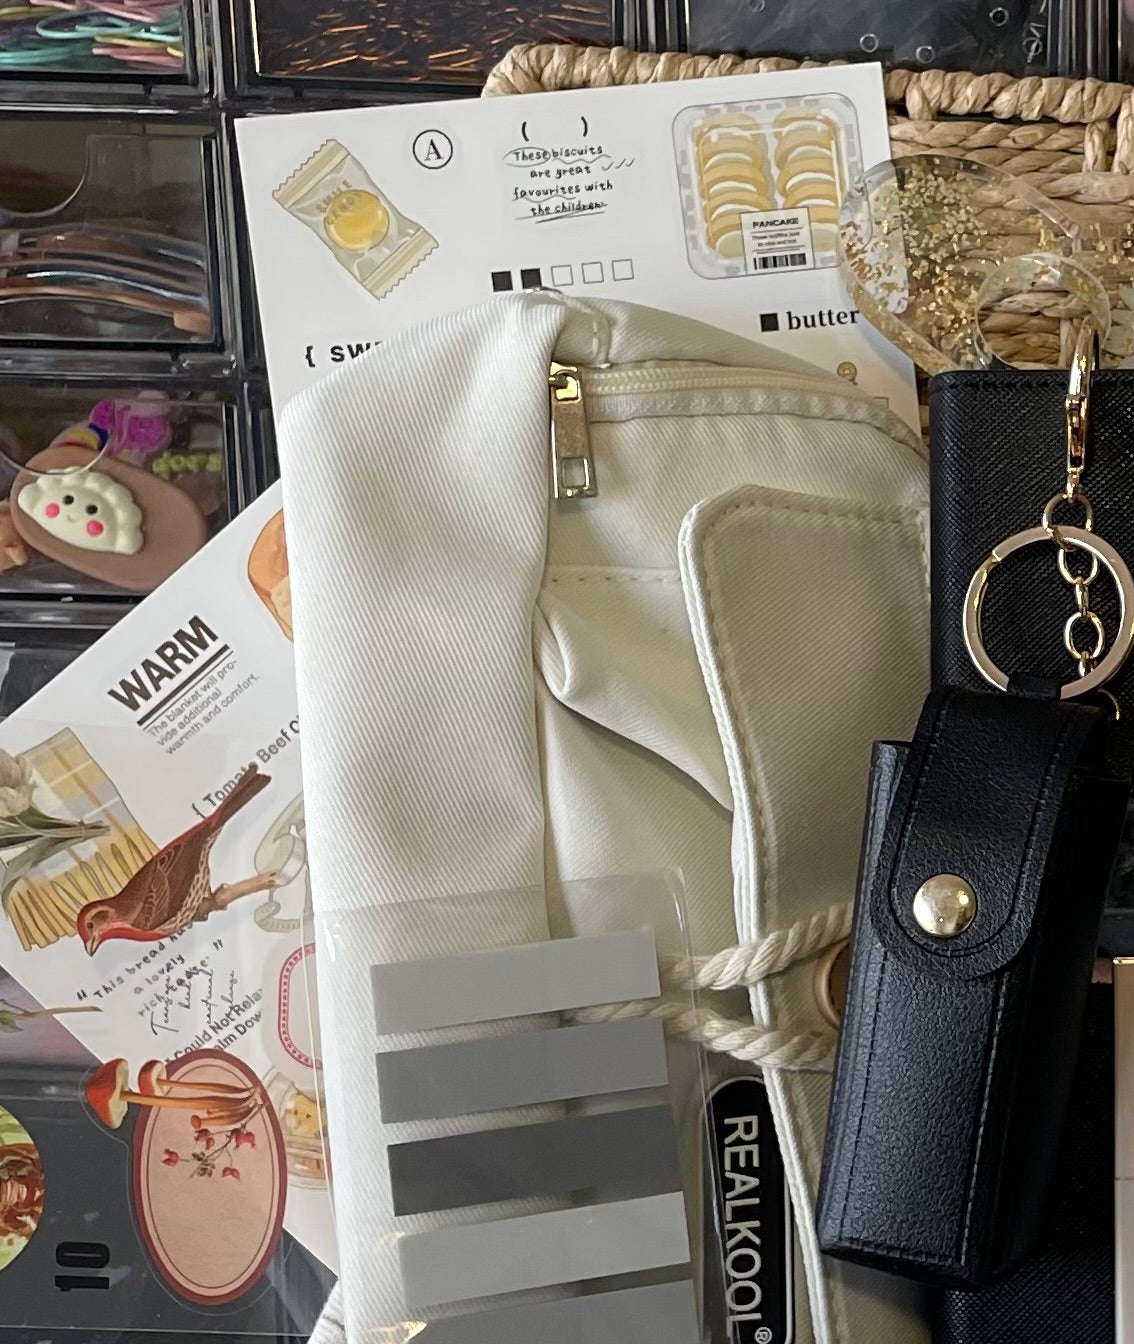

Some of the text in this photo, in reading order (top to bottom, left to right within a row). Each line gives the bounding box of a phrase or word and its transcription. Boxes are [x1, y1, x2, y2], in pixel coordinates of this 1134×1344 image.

[513, 144, 603, 161] These biscuits
[530, 165, 591, 179] are great
[512, 179, 614, 201] favourites with
[530, 203, 551, 216] the
[752, 217, 799, 229] PANCAKE
[786, 309, 860, 330] butter
[107, 615, 219, 712] WARM
[147, 720, 168, 738] The
[165, 689, 201, 722] blanket
[200, 675, 218, 693] will
[157, 687, 223, 747] vide additional
[166, 720, 205, 755] warmth
[202, 705, 223, 725] and
[256, 728, 292, 763] Beef
[92, 975, 125, 1000] This
[126, 942, 166, 975] bread
[145, 954, 185, 985] lovely
[213, 1008, 237, 1036] Not
[234, 987, 263, 1018] Rela
[724, 1114, 762, 1337] REALKOOL
